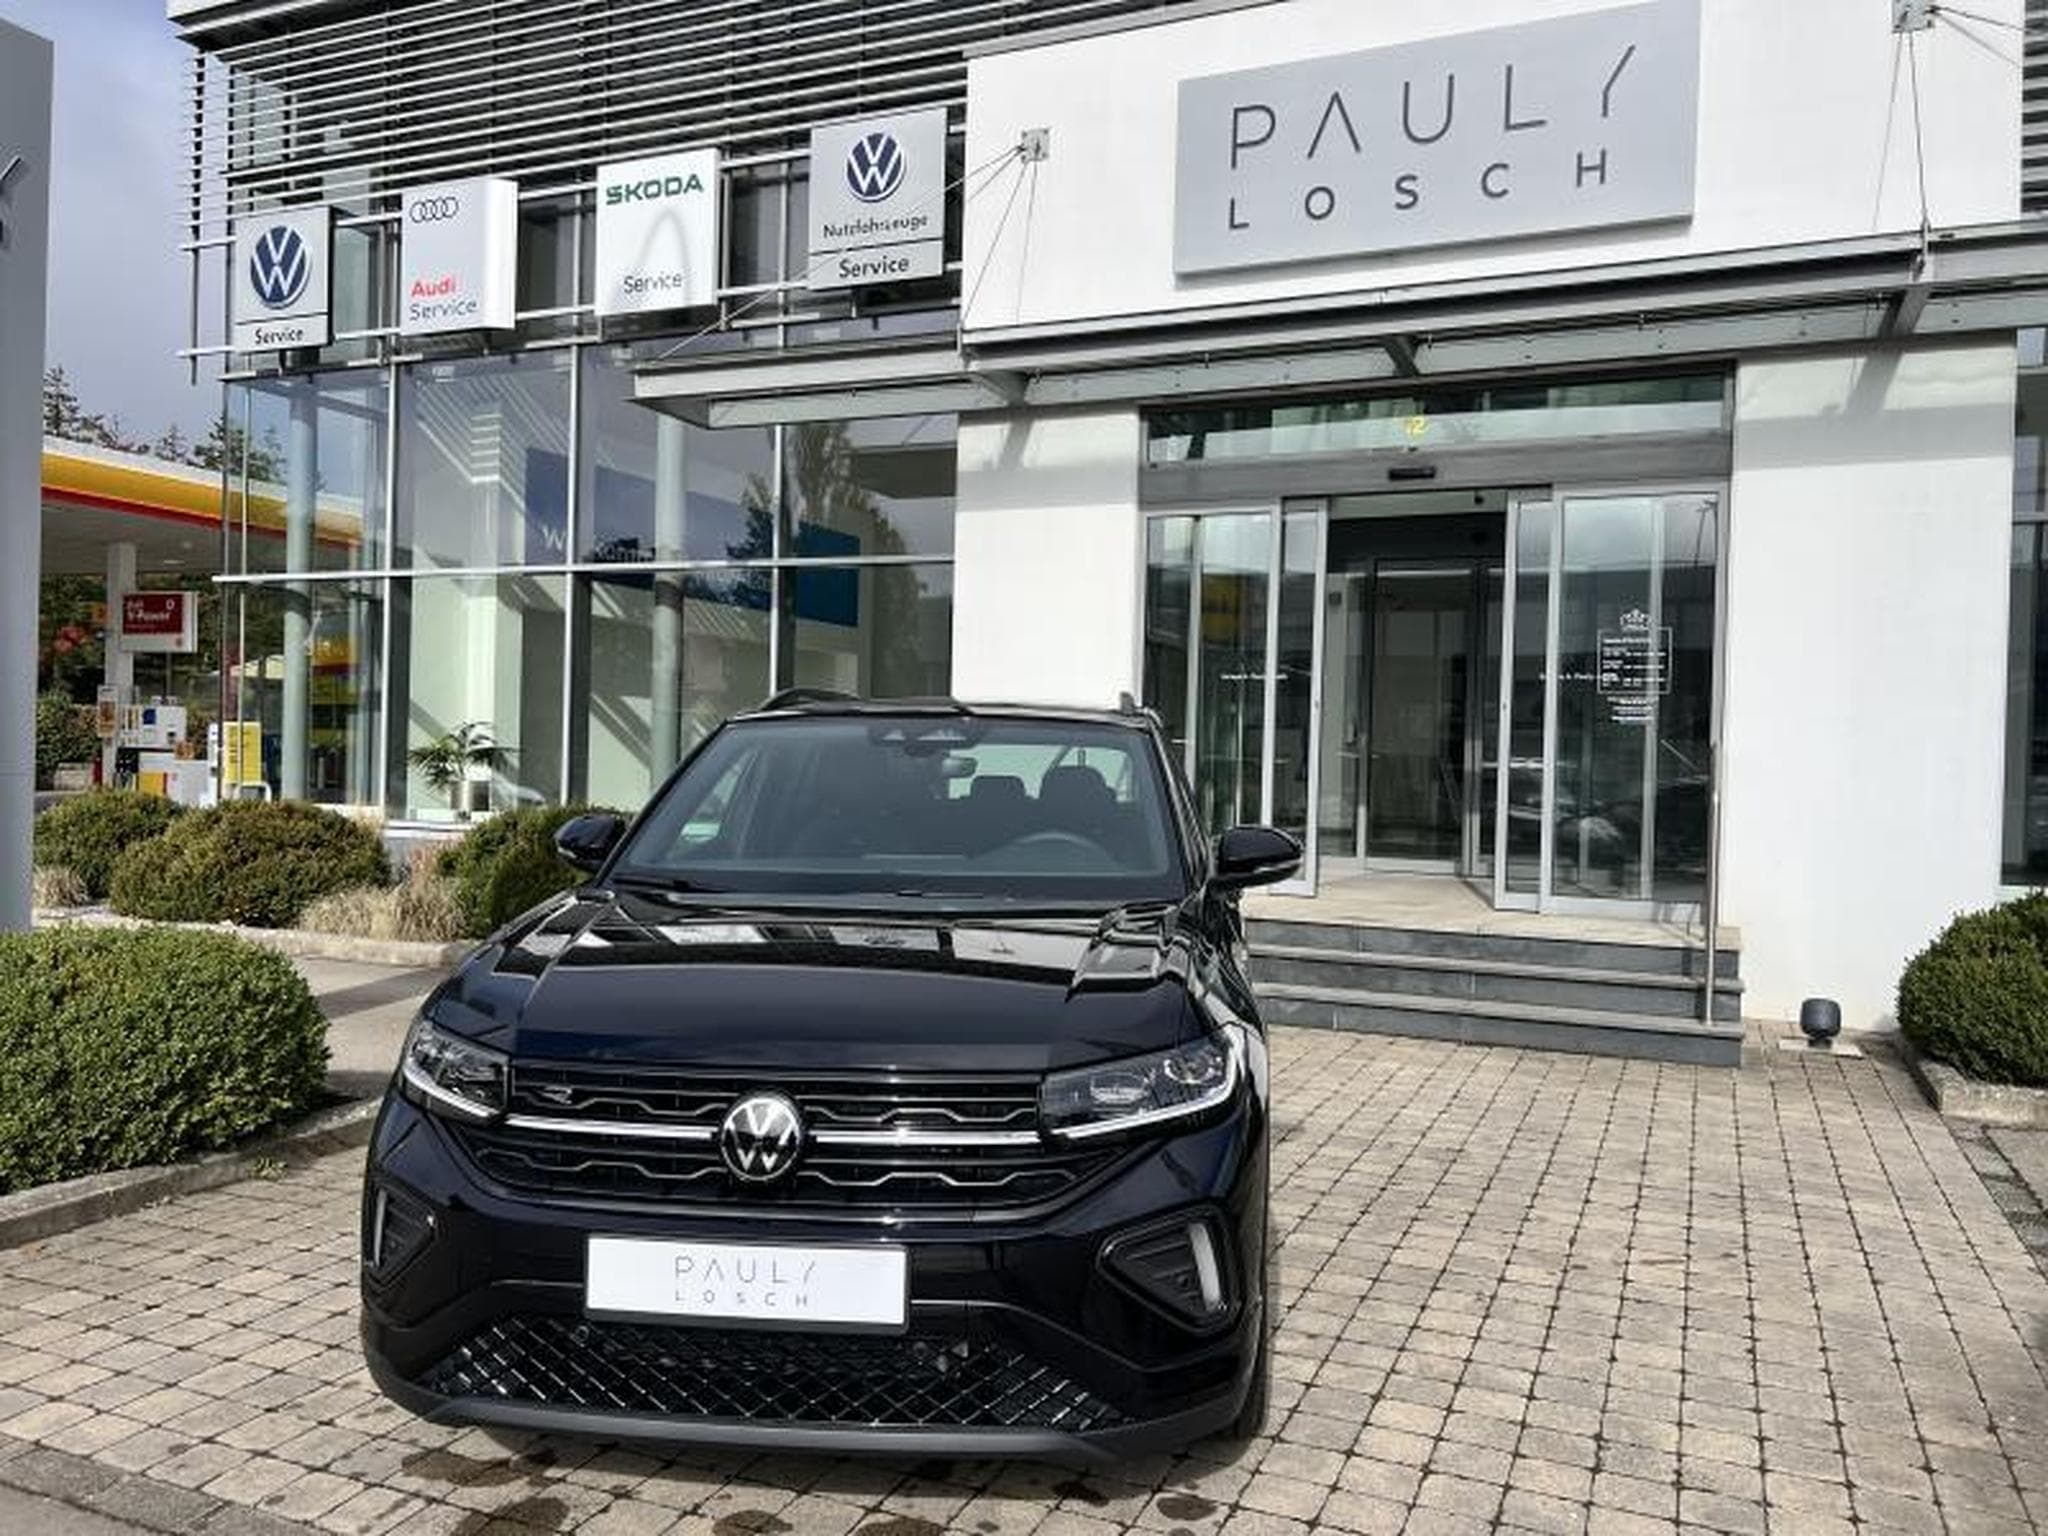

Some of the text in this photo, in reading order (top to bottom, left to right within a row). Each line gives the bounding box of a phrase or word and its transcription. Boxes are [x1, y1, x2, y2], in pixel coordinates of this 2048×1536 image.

[1231, 44, 1636, 169] PAULY
[1229, 149, 1607, 230] LOSCH
[839, 255, 910, 279] Service
[411, 277, 456, 298] Audi
[624, 271, 683, 294] Service
[409, 299, 477, 321] Service
[255, 326, 303, 345] Service
[675, 1255, 816, 1284] PAULY
[675, 1290, 808, 1307] LOSCH
